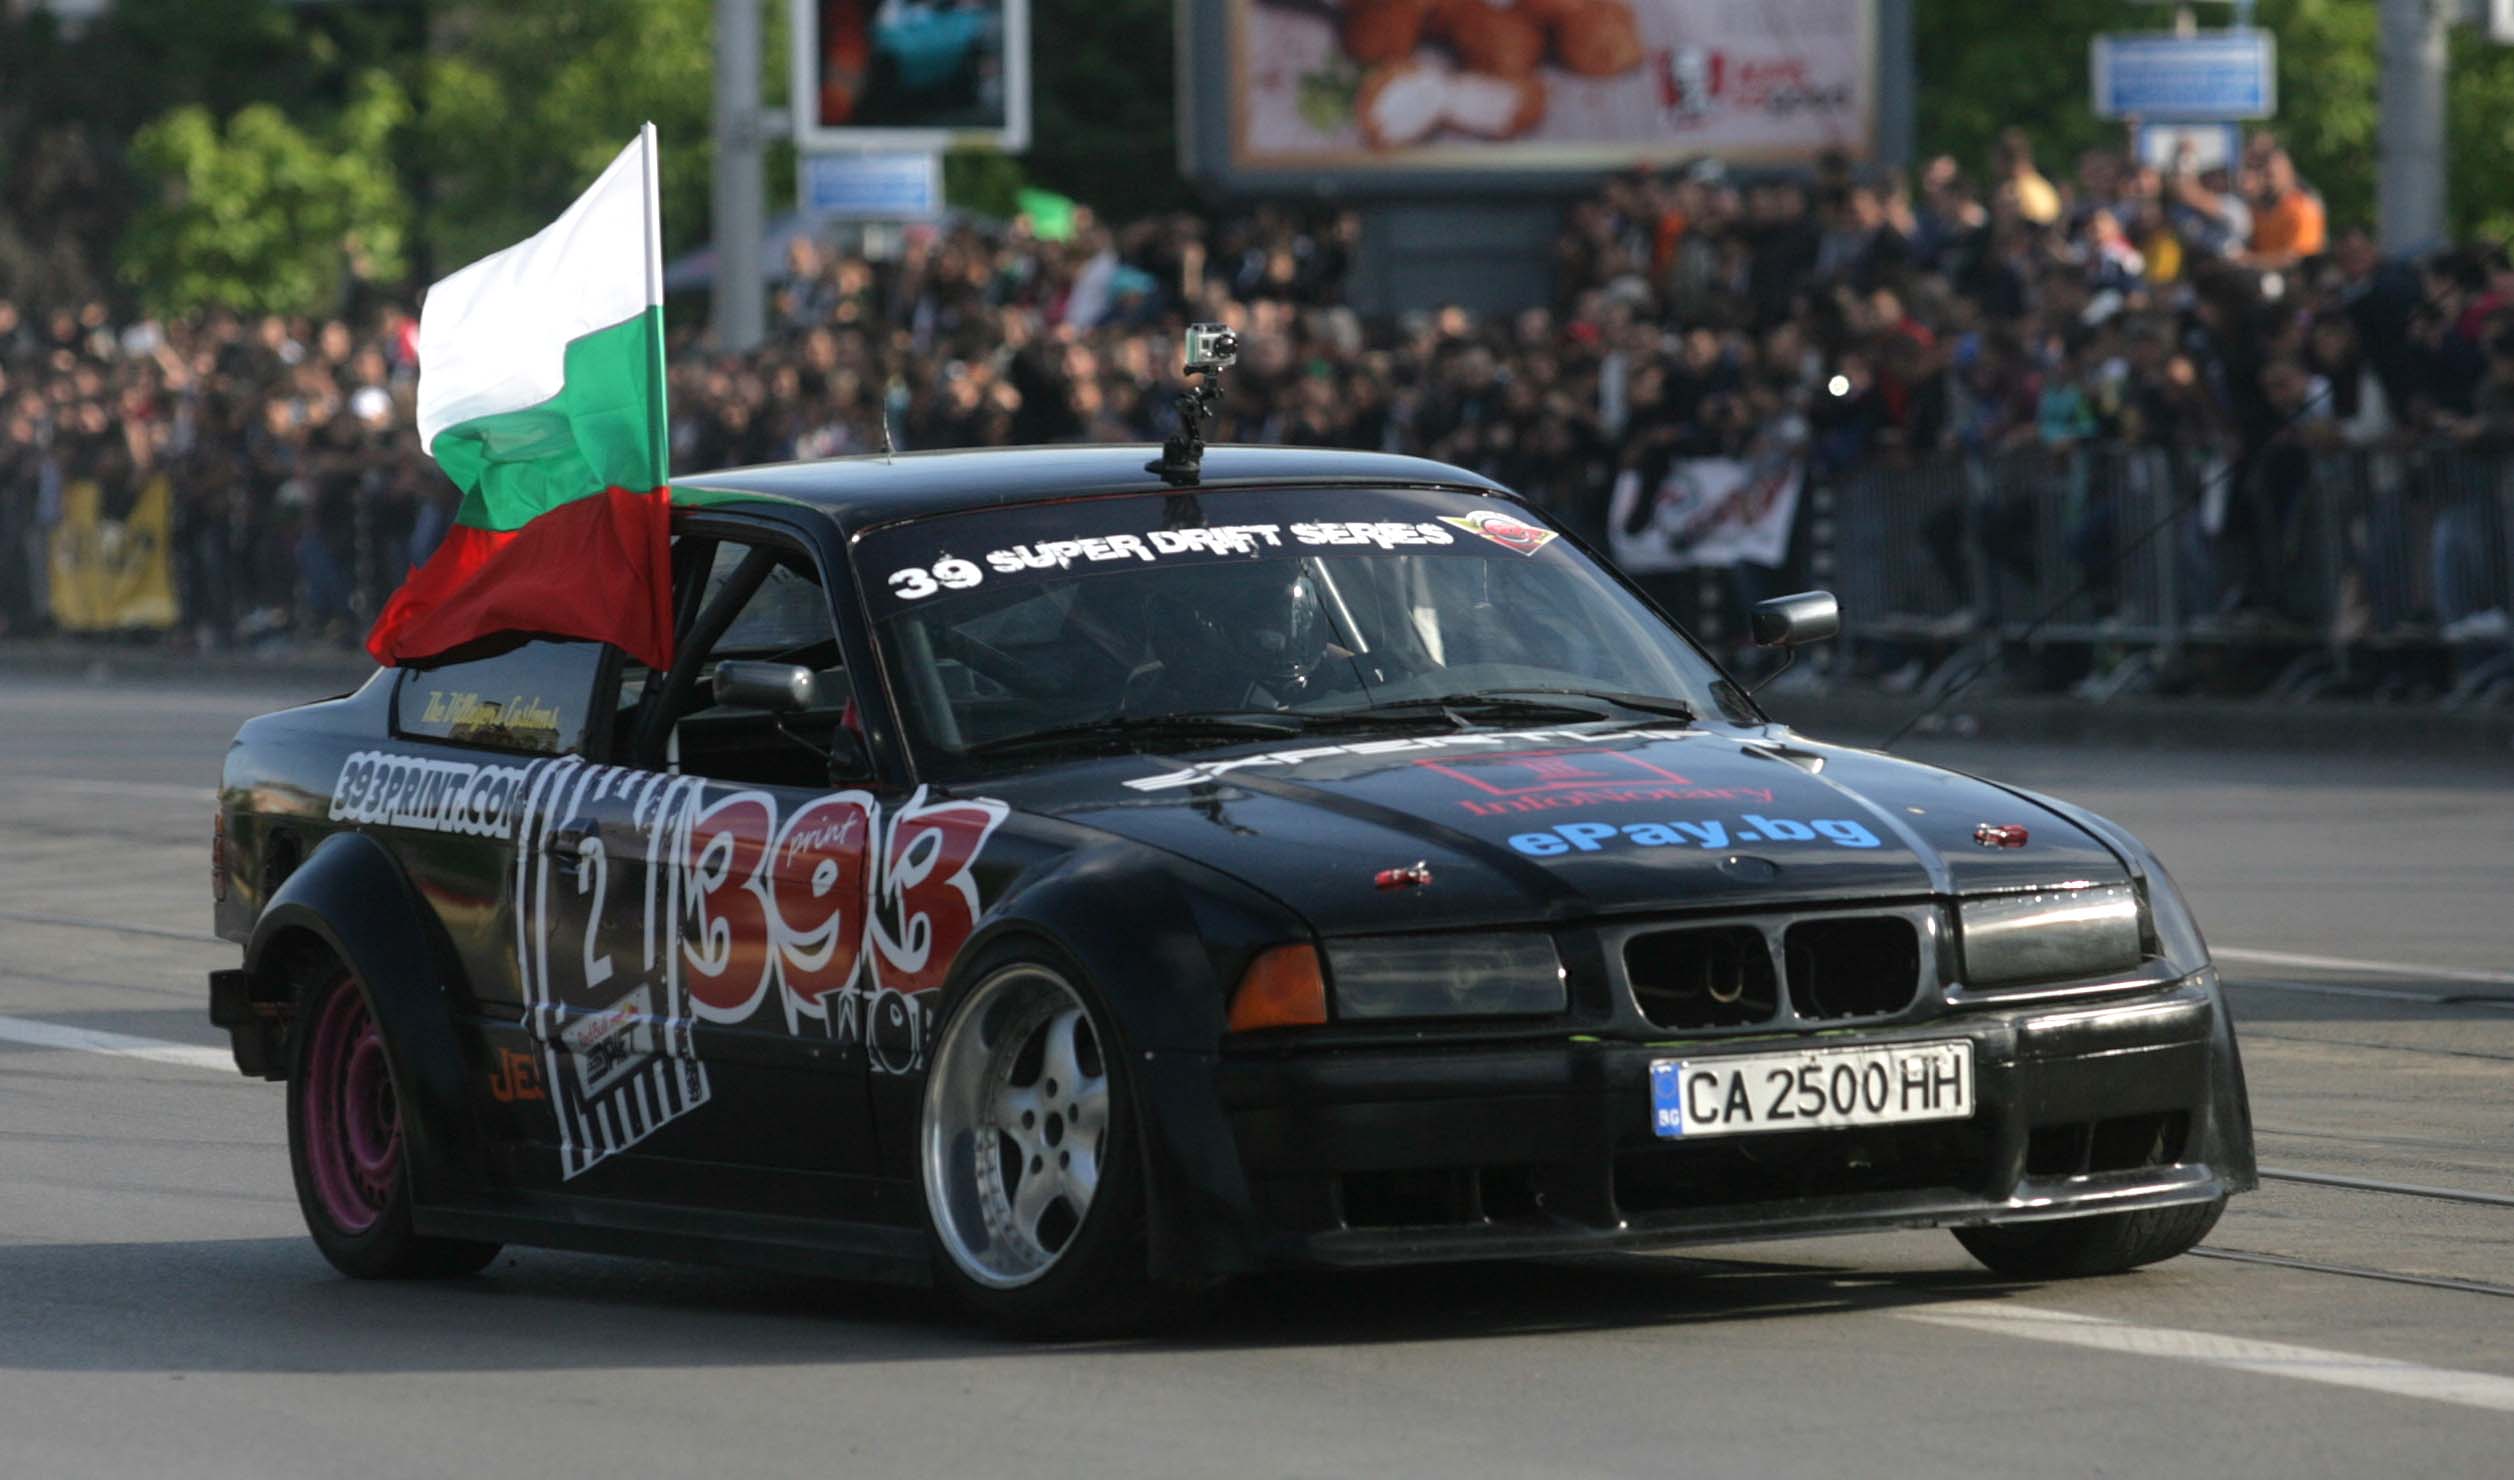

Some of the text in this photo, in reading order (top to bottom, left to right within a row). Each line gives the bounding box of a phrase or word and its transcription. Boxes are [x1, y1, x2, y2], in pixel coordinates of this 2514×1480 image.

[888, 558, 983, 600] 39
[986, 534, 1155, 573] SUPER
[1146, 525, 1281, 556] DRIFT
[1290, 521, 1454, 550] SERIES
[787, 811, 858, 868] print
[1508, 814, 1882, 856] ePay.bg
[578, 836, 613, 989] 2
[683, 784, 1010, 1036] 393
[1658, 1108, 1680, 1126] BG
[1688, 1054, 1962, 1125] CA 2500 HH
